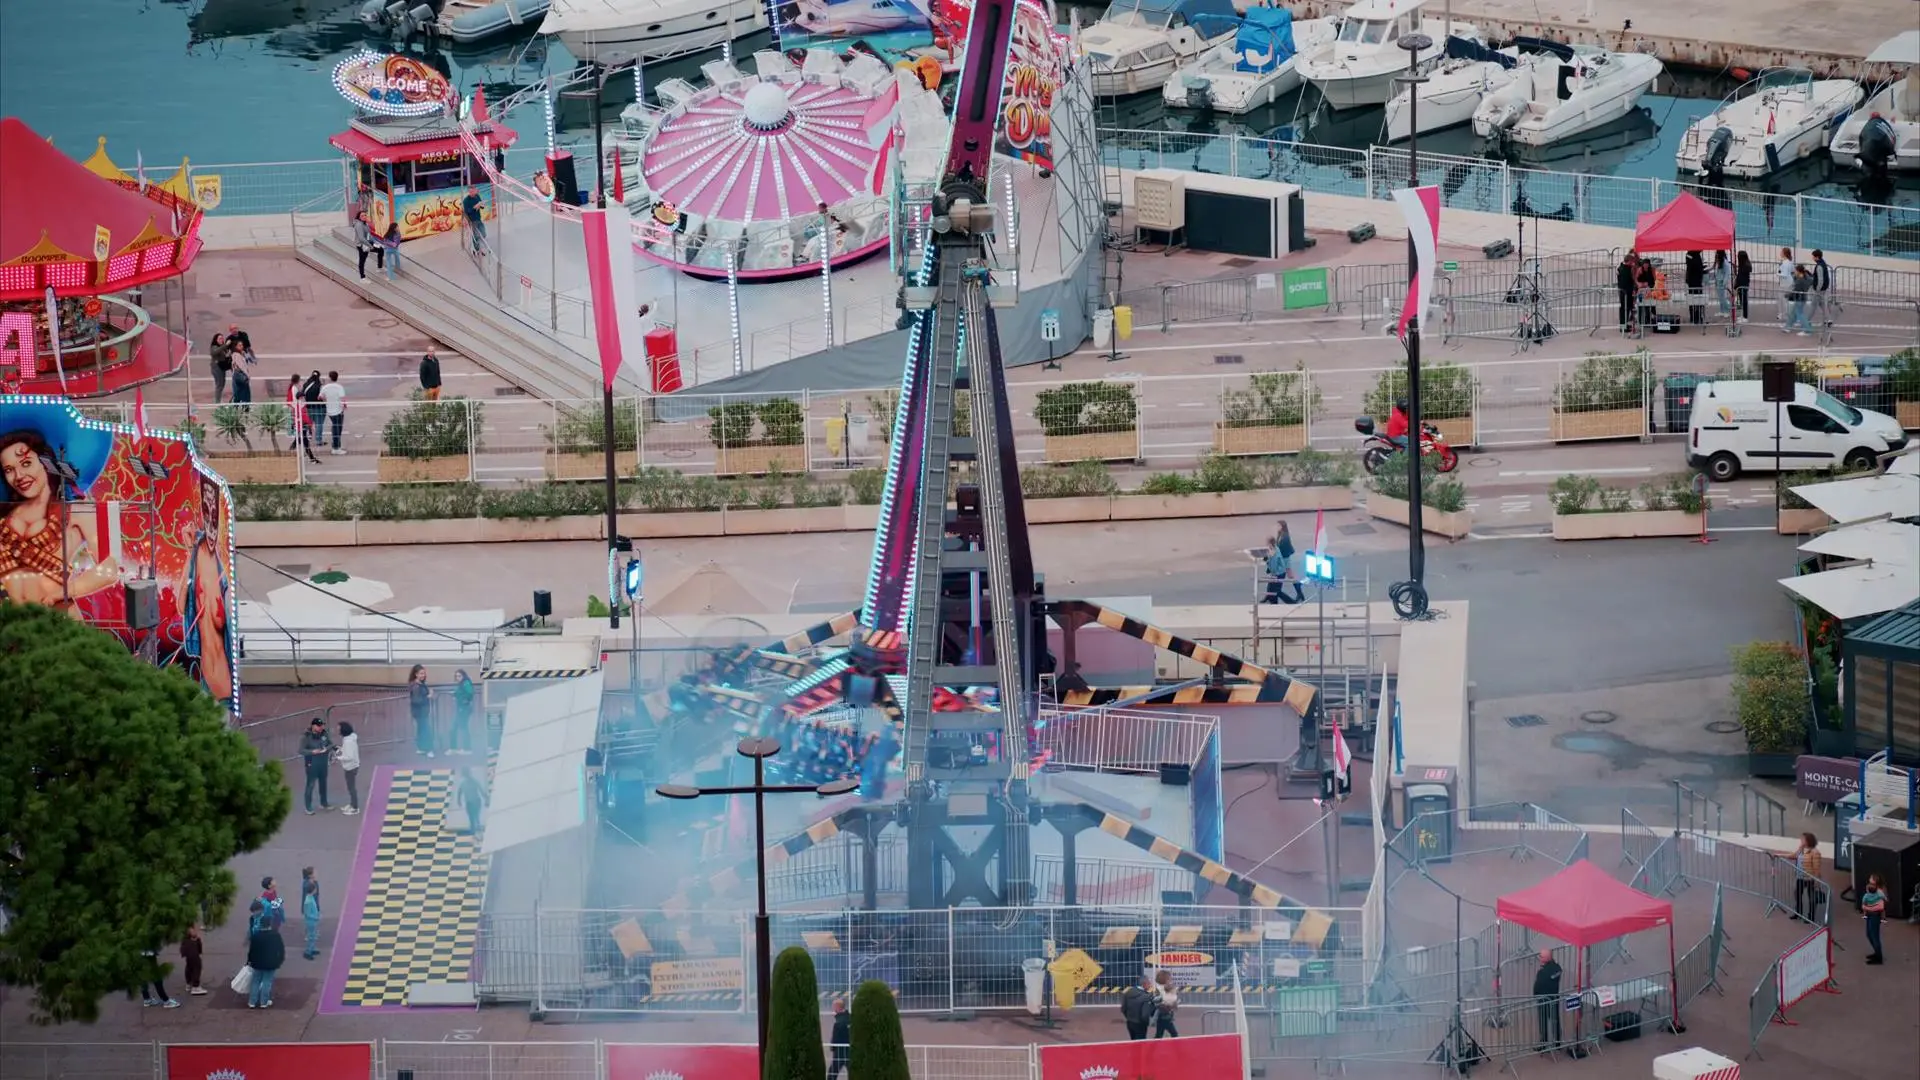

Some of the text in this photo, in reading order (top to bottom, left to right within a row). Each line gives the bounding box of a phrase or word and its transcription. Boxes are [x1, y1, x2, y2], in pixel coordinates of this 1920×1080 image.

[358, 75, 427, 92] WELCOME
[21, 253, 67, 264] BOOMPER
[1289, 281, 1322, 293] SORTIE
